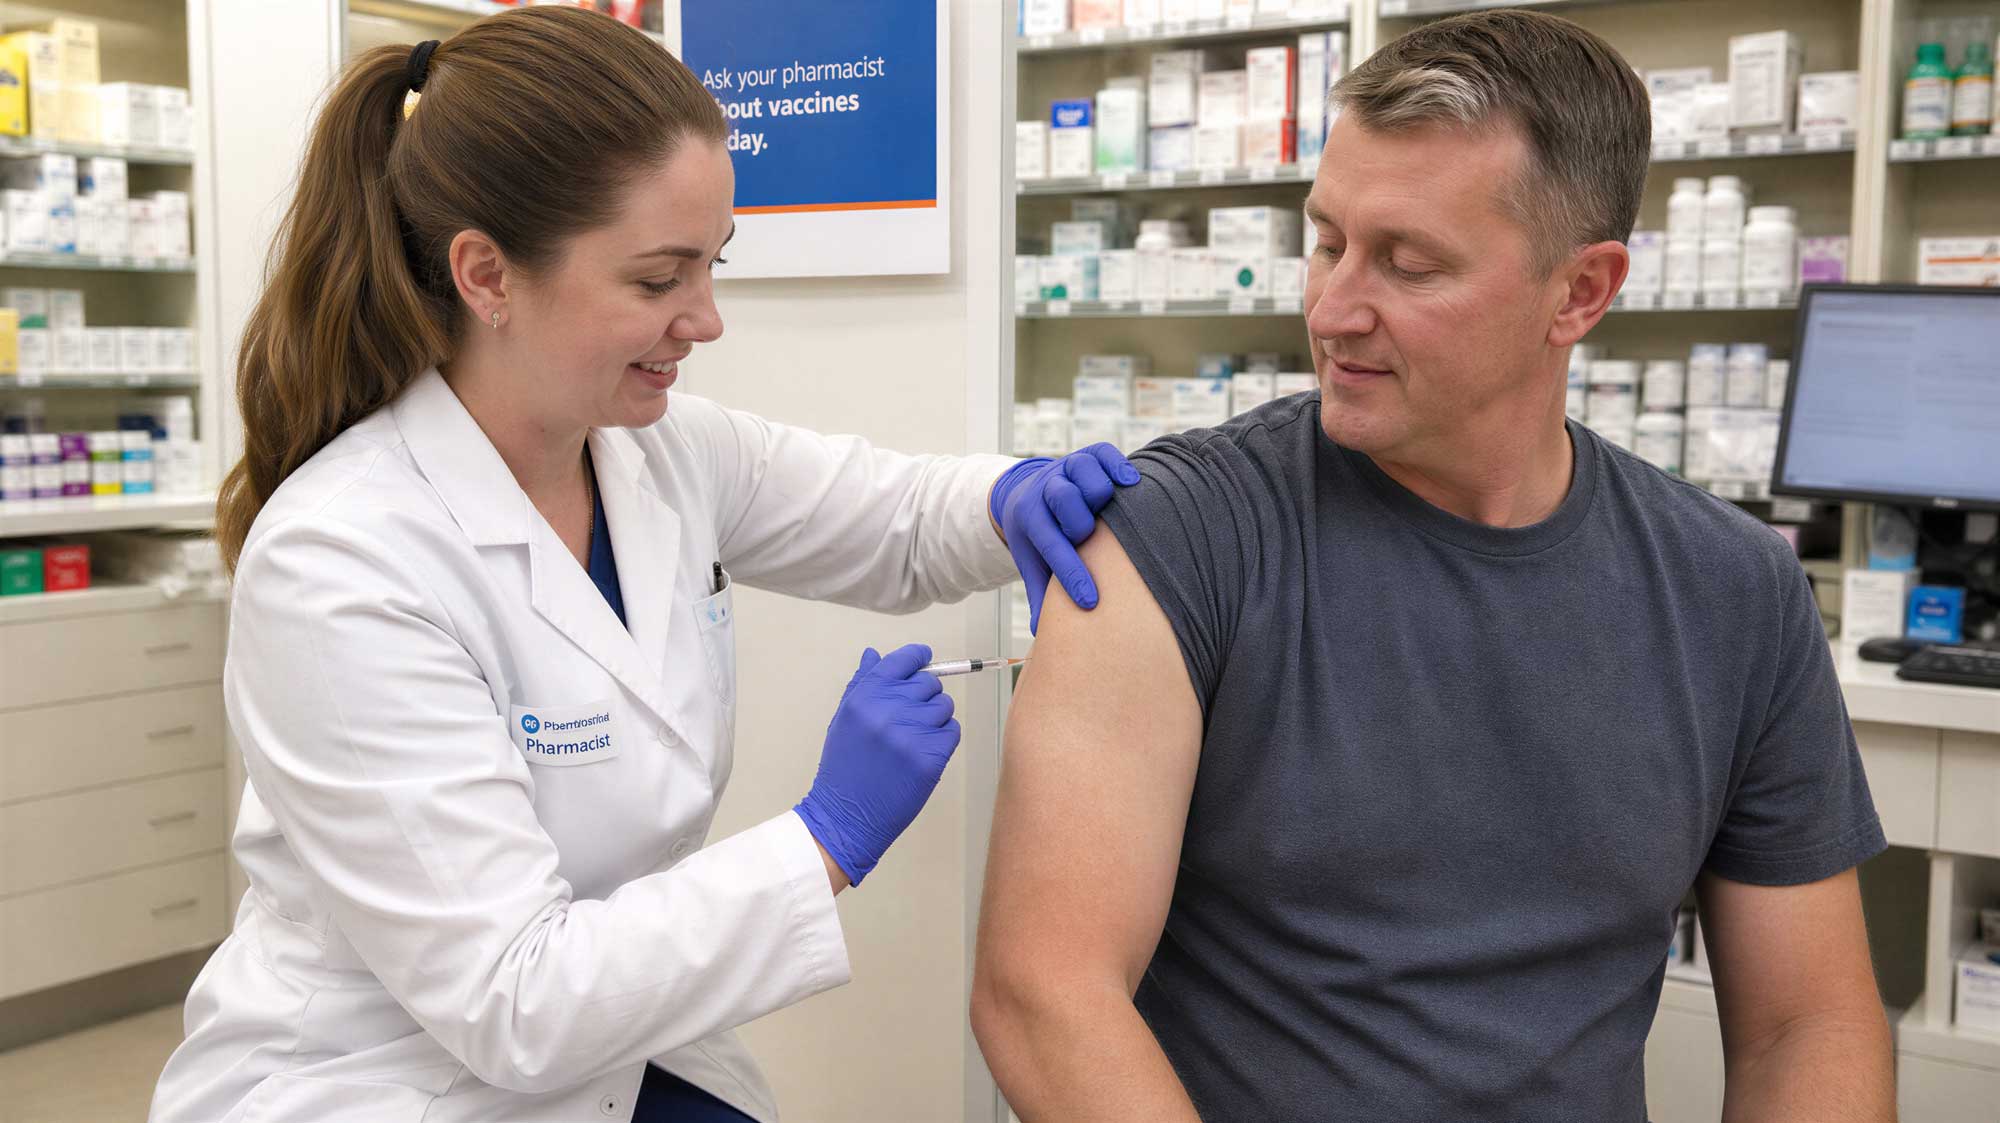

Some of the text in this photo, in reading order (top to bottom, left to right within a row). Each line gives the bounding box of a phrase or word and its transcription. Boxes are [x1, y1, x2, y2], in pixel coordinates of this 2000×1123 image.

[703, 56, 885, 92] Ask your pharmacist
[715, 91, 860, 119] bout vaccines
[725, 128, 768, 156] day.
[526, 733, 611, 755] Pharmacist
